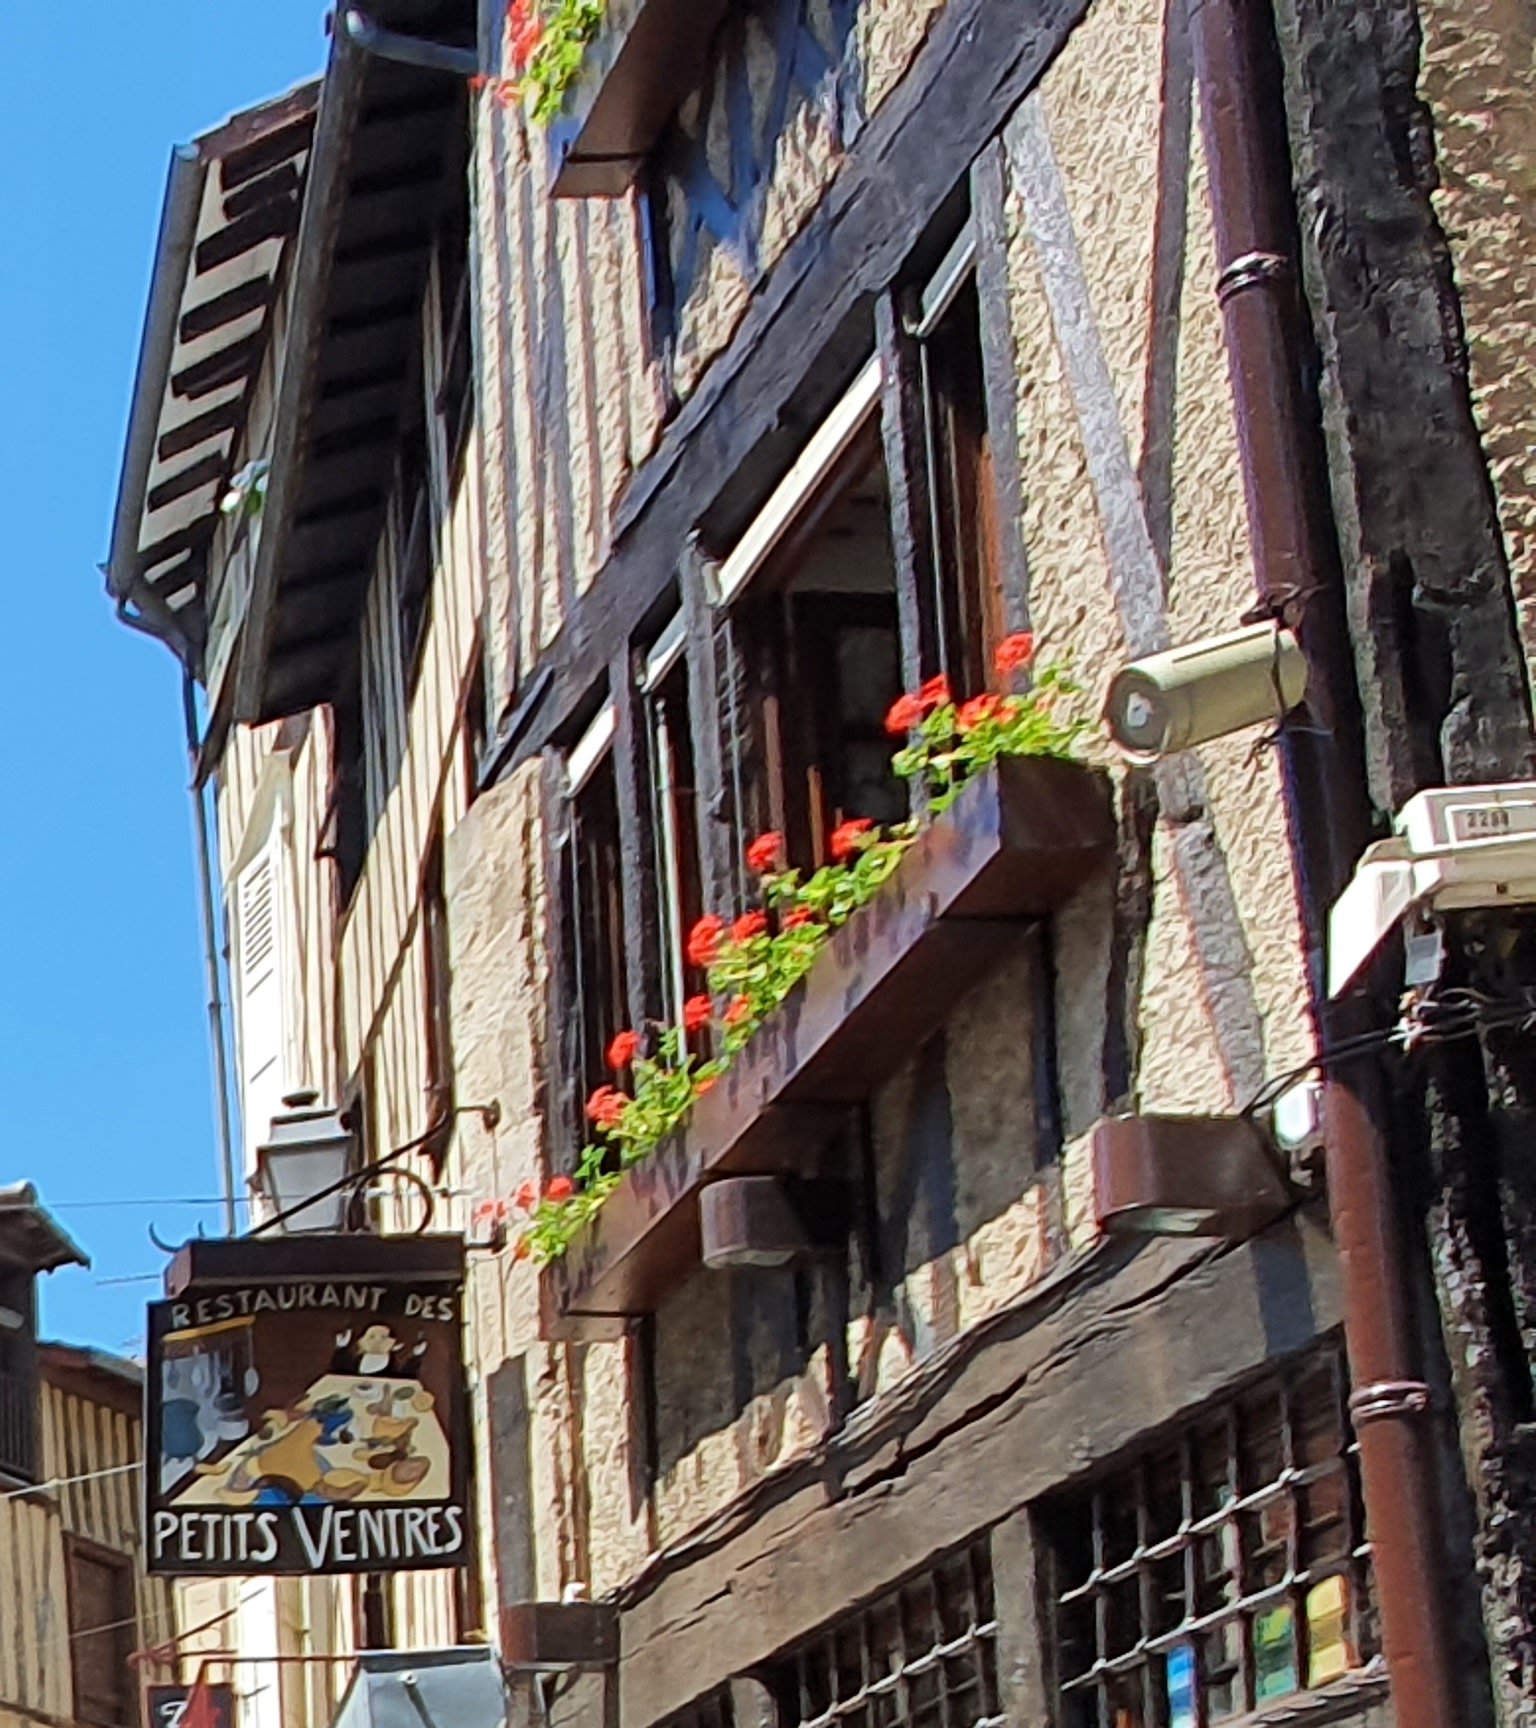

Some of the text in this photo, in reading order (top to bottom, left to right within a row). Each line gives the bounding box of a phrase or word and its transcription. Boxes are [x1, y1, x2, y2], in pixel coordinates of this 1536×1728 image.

[171, 1286, 455, 1329] RESTAURANT DES
[154, 1505, 464, 1570] PETITS VENTRES
